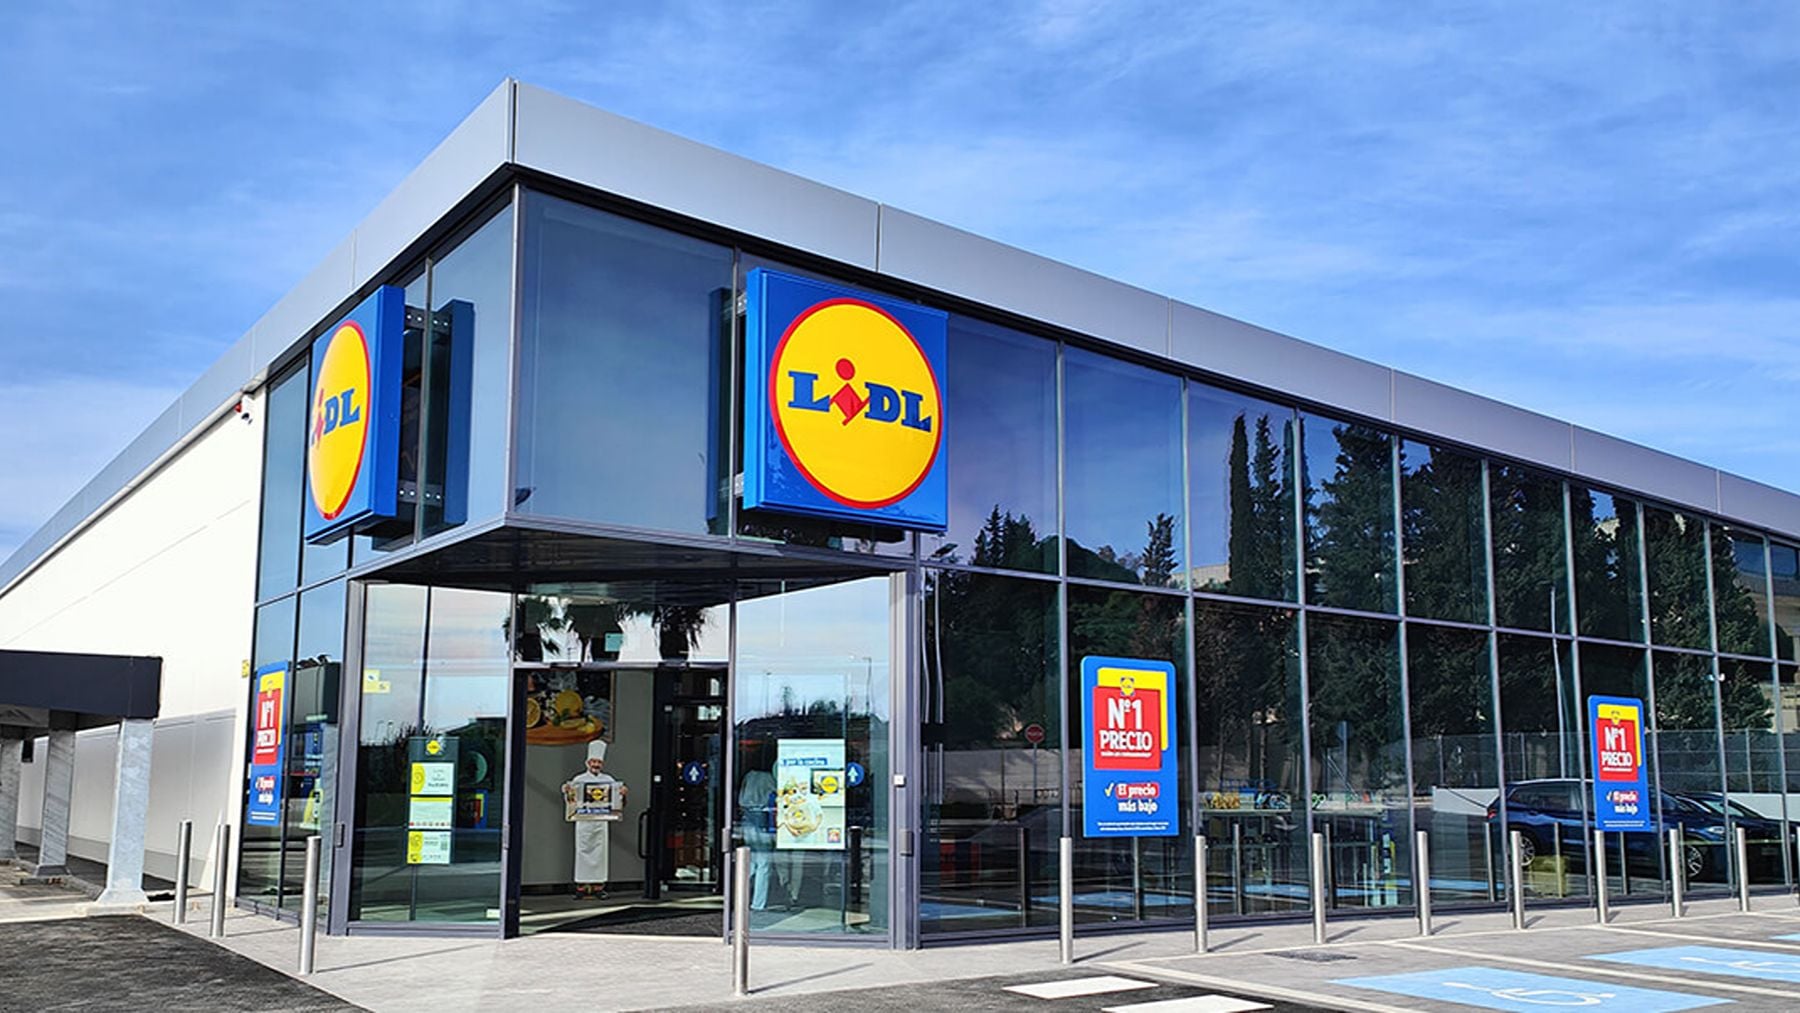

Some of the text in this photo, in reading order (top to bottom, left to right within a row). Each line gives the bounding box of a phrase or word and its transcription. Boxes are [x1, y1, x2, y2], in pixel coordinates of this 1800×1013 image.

[1099, 729, 1153, 751] PRECIO
[1117, 782, 1157, 799] El precio
[1118, 798, 1158, 815] más bajo
